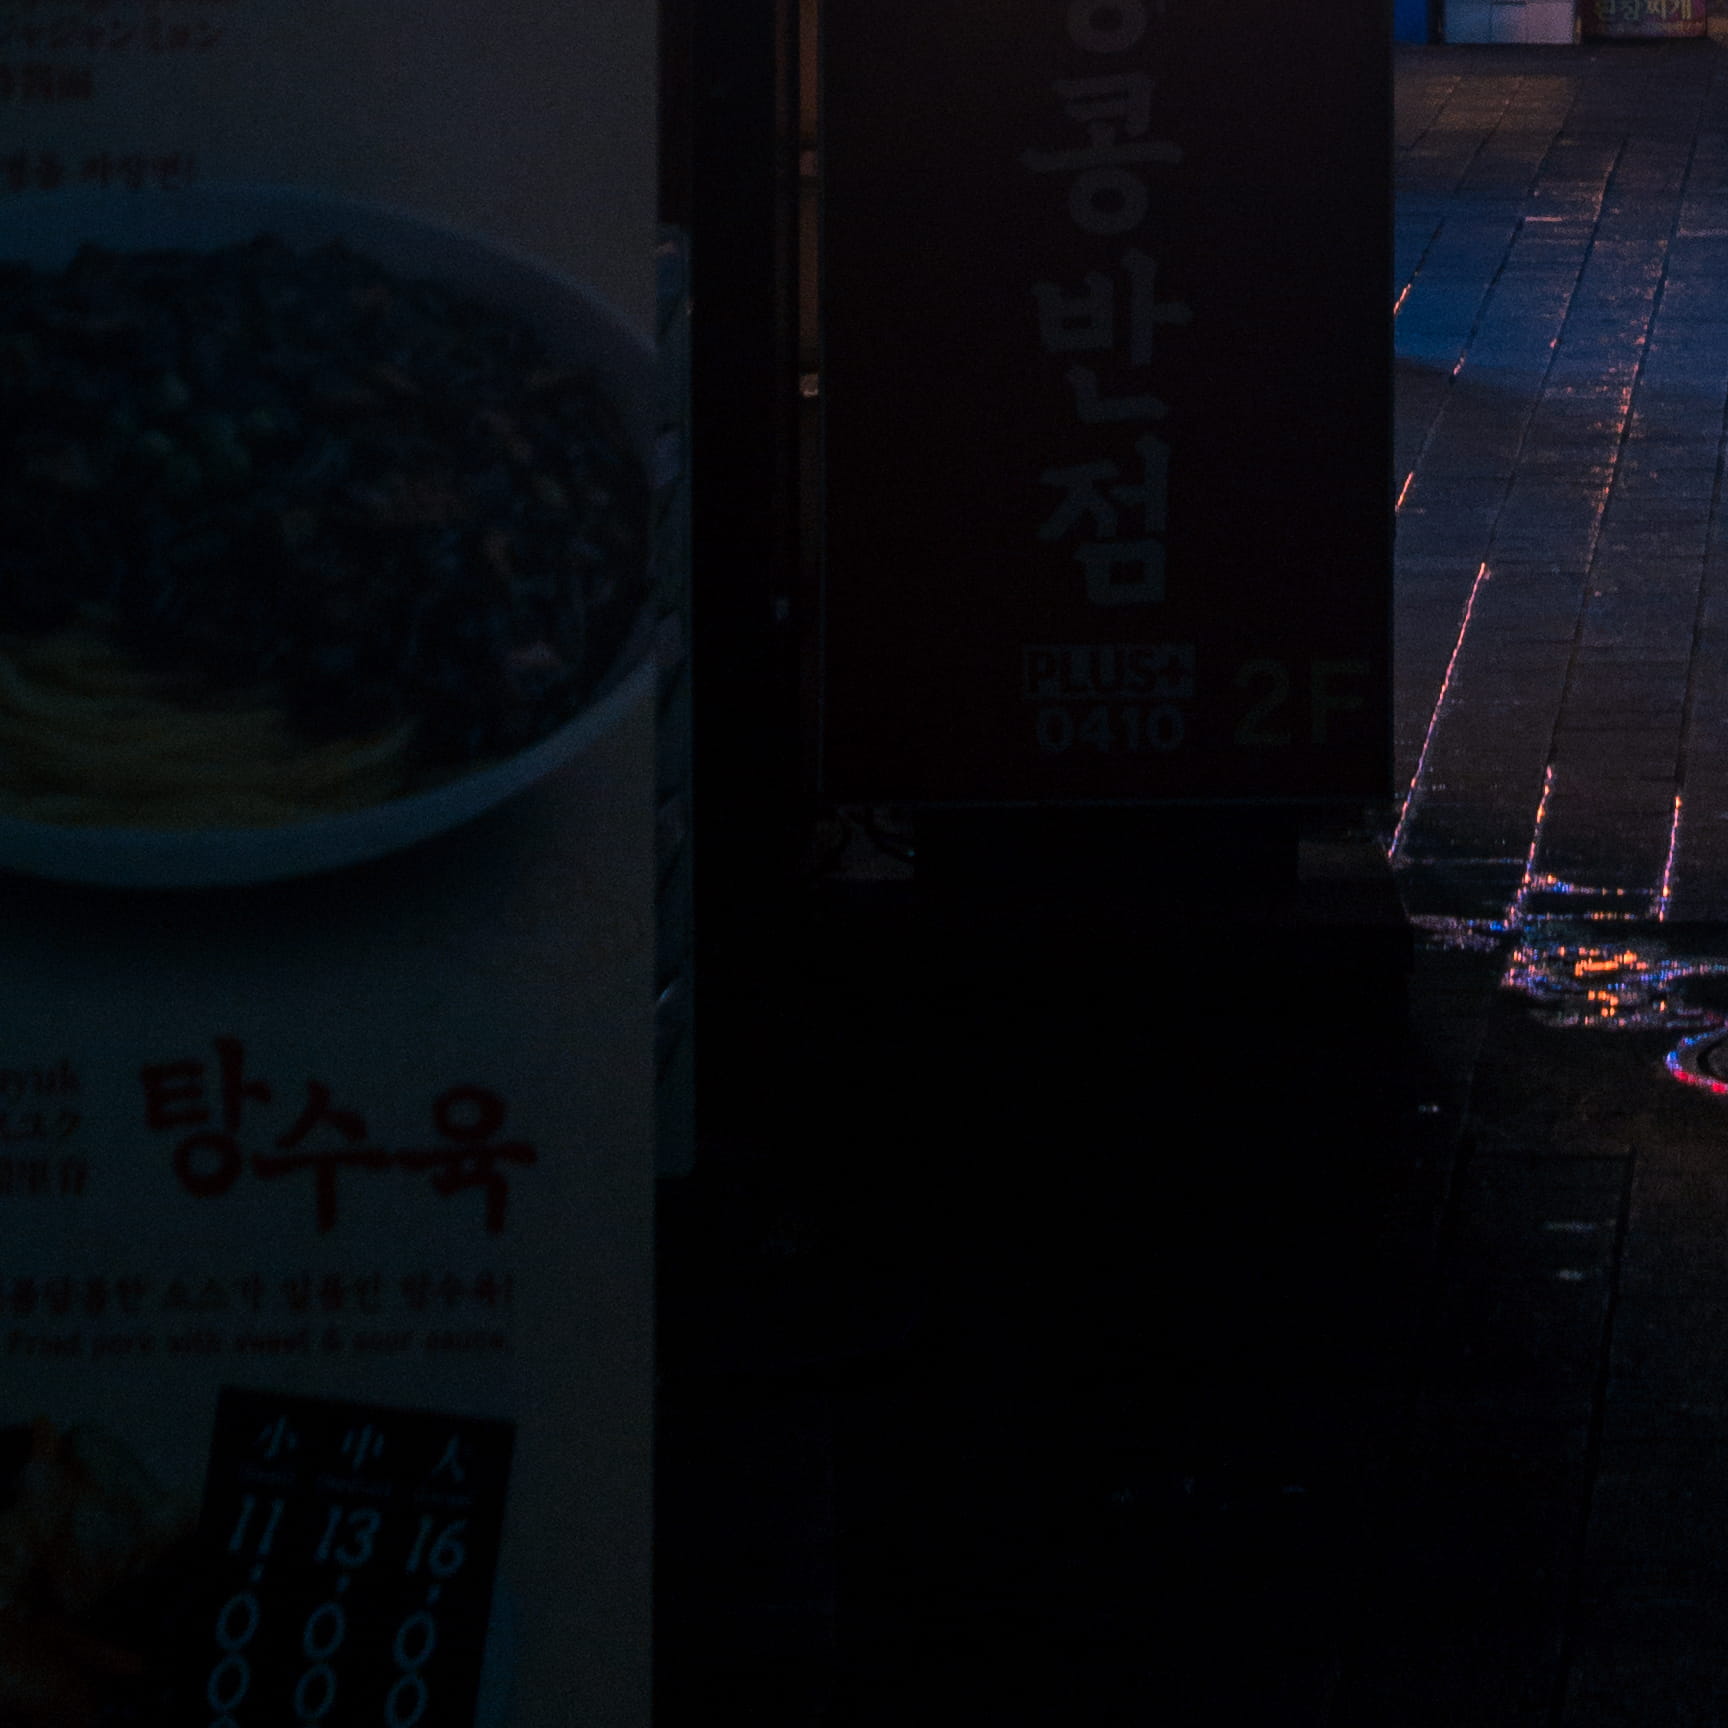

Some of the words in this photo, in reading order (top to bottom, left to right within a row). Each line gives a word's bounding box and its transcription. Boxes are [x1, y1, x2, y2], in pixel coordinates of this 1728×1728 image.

[1035, 707, 1185, 753] 0410
[1232, 656, 1374, 751] 2F
[138, 1034, 538, 1237] 탕수육
